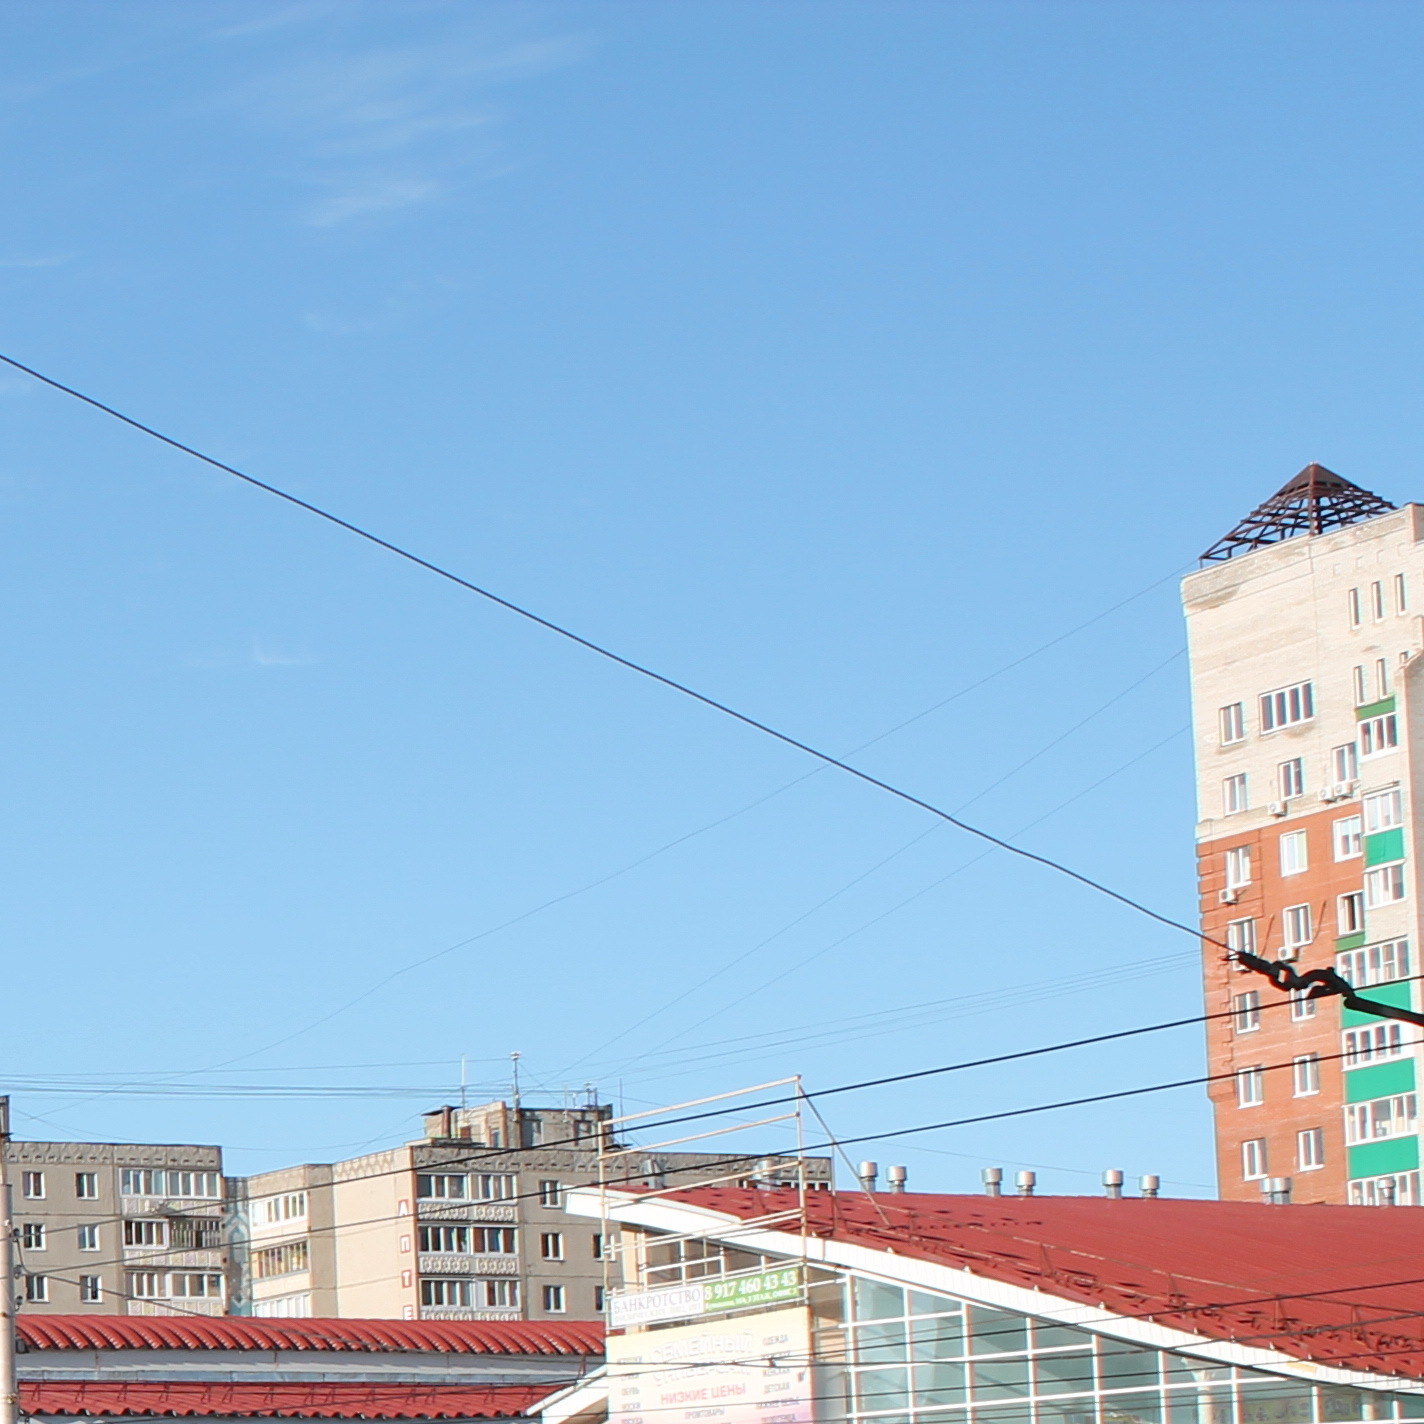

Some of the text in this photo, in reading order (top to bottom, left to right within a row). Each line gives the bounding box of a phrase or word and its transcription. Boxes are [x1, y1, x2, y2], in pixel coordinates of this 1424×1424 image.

[705, 1270, 798, 1300] 8 917 460 43 43
[614, 1288, 701, 1314] БАНКРОТСТВО
[651, 1330, 754, 1364] СЕМЕЙНЫЙ
[660, 1383, 746, 1405] НИЗКИЕ ЦЕНЫ
